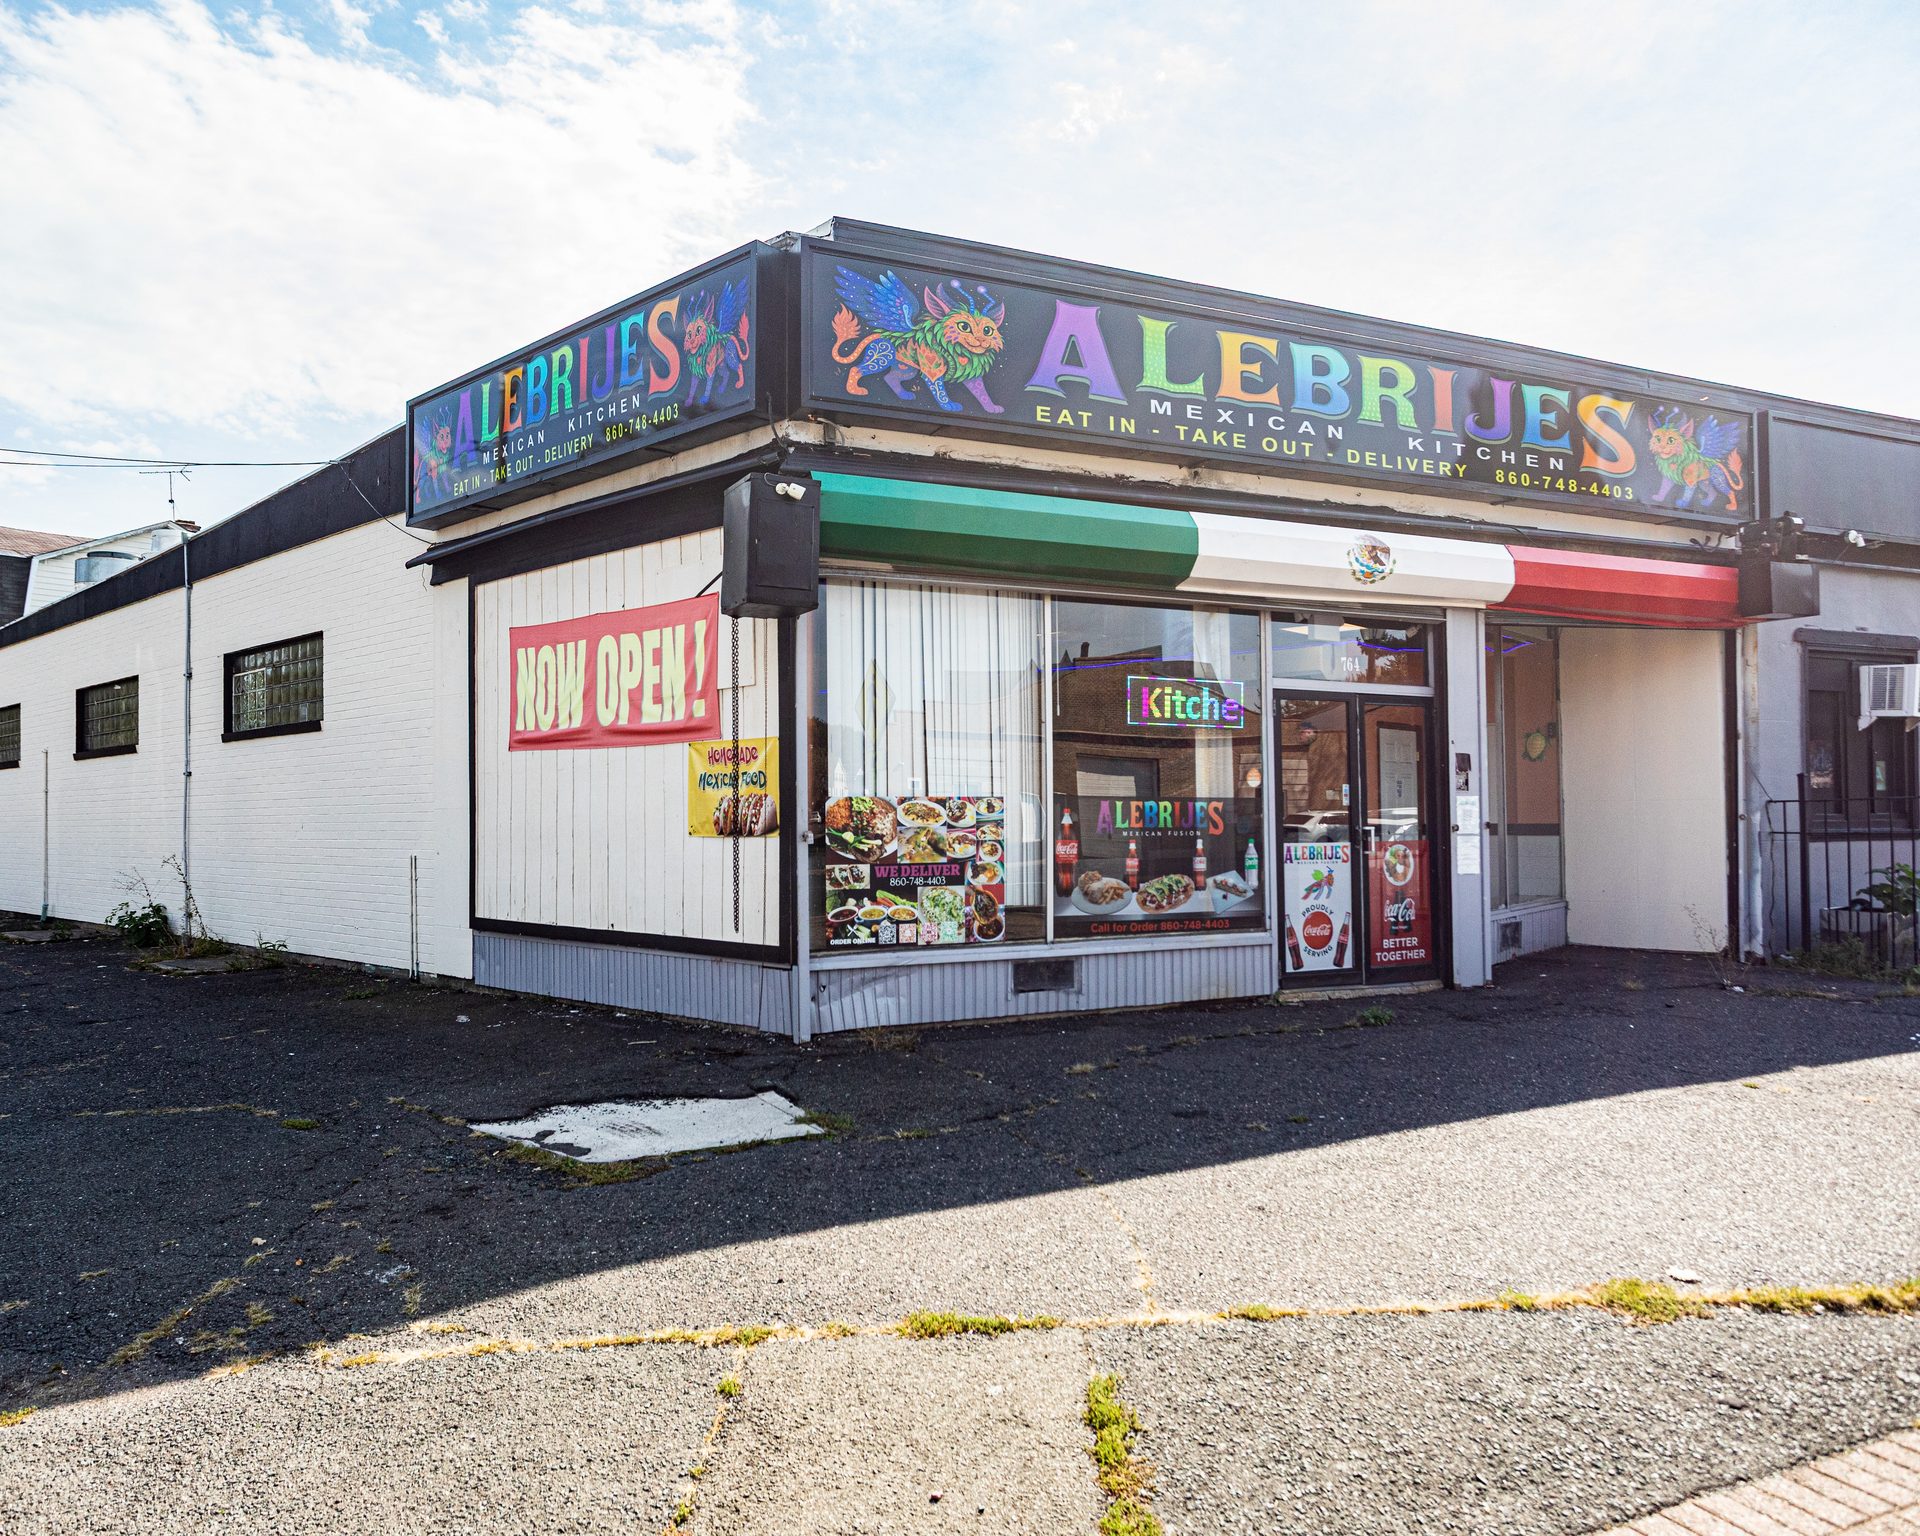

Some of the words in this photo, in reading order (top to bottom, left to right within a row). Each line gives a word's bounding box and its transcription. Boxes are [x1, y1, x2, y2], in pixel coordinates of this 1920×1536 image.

[452, 294, 681, 470] ALEBRIJES
[1024, 299, 1637, 478] ALEBRIJES
[482, 430, 545, 464] MEXICAN
[568, 393, 641, 433] KITCHEN
[1150, 399, 1344, 440] MEXICAN
[1408, 437, 1564, 471] KITCHEN
[453, 480, 468, 497] EAT
[472, 475, 480, 489] IN
[490, 464, 512, 482] TAKE
[516, 457, 534, 474] OUT
[545, 433, 594, 464] DELIVERY
[605, 403, 679, 442] 860-748-4403
[1035, 405, 1092, 427] EAT
[1109, 415, 1136, 434] IN
[1175, 425, 1247, 449] TAKE
[1262, 437, 1313, 457] OUT
[1347, 449, 1467, 478] DELIVERY
[1495, 470, 1634, 499] 860-748-4403
[515, 639, 587, 732] NOW
[596, 619, 706, 728] OPEN!
[1341, 656, 1359, 671] 764
[1141, 686, 1239, 721] Kitche
[1096, 800, 1225, 836] ALEBRIJES
[1284, 845, 1350, 864] ALEBRIJES
[874, 865, 899, 878] WE
[901, 864, 960, 877] DELIVER
[889, 876, 946, 887] 860-748-4403
[1301, 904, 1335, 918] PROUDLY
[1090, 923, 1110, 933] Call
[1113, 922, 1127, 933] for
[1129, 922, 1157, 932] Order
[1160, 919, 1230, 931] 860-748-4403
[1303, 945, 1333, 958] SERVING
[1376, 949, 1426, 962] TOGETHER
[1383, 937, 1419, 949] BETTER
